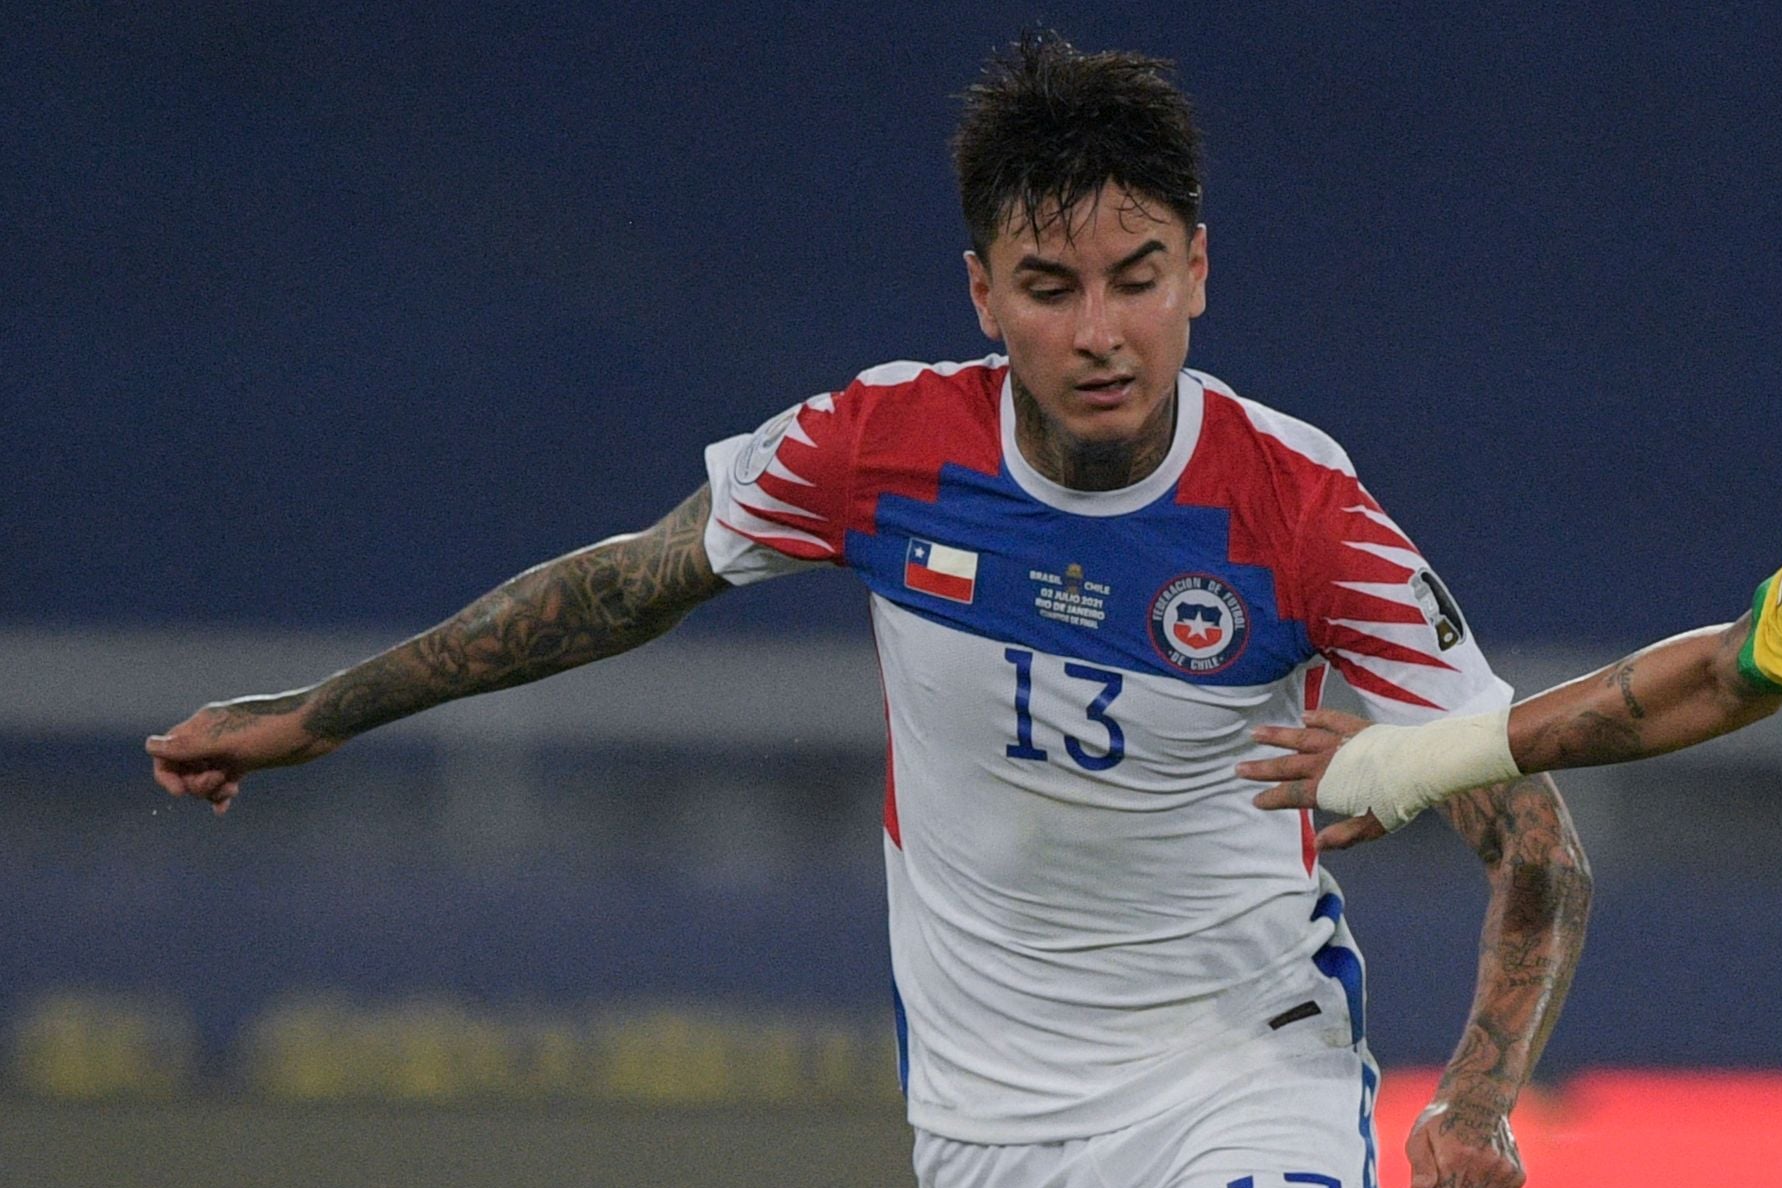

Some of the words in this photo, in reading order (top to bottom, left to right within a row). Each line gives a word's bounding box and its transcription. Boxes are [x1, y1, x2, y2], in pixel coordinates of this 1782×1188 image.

[1040, 587, 1054, 598] 02
[1054, 590, 1080, 603] JULIO
[1084, 581, 1111, 595] CHILE
[1208, 580, 1222, 594] DE
[1170, 651, 1185, 666] DE
[1190, 656, 1219, 670] CHILE
[1003, 646, 1126, 771] 13
